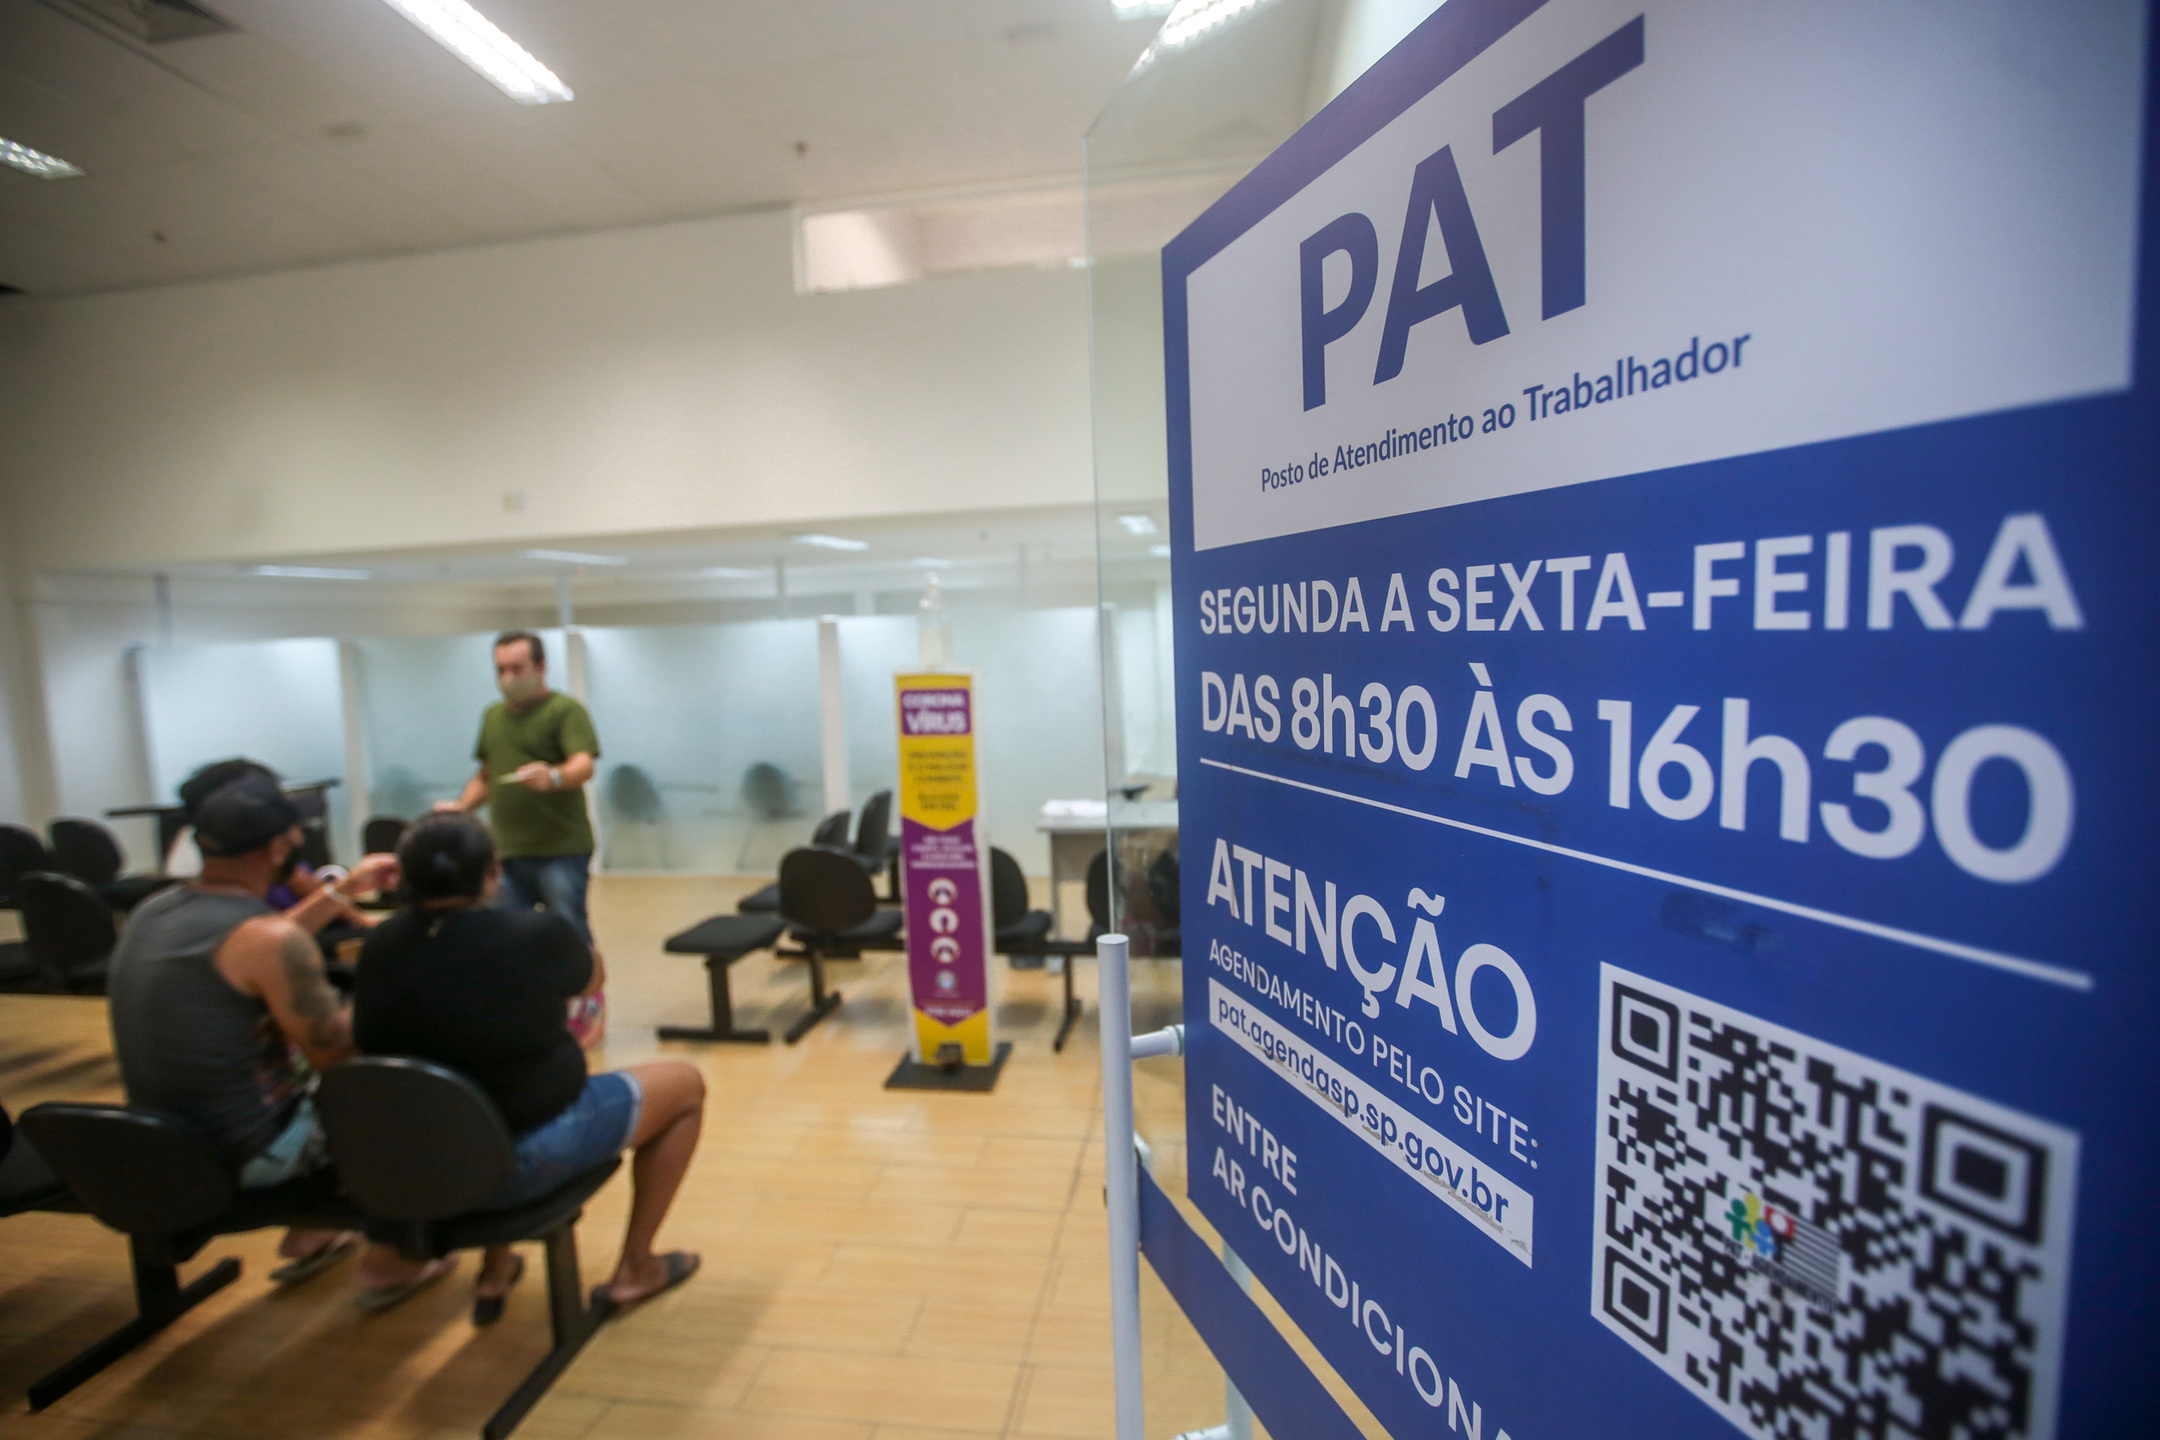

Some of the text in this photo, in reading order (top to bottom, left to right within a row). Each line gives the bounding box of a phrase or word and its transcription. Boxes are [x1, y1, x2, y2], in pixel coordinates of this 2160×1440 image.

[1299, 12, 1645, 412] PAT
[1261, 332, 1752, 493] Posto de Atendimento ao Trabalhador
[1200, 513, 2085, 635] SEGUNDA A SEXTA-FEIRA
[1201, 662, 2075, 884] DAS 8h30 ÀS 16h30
[1206, 838, 1537, 1061] ATENÇÃO
[1209, 938, 1539, 1170] AGENDAMENTO PELO SITE:
[1212, 1083, 1298, 1196] ENTRE
[1218, 996, 1509, 1224] pat.agendasp.sp.gov.br
[1212, 1146, 1512, 1440] AR CONDICION
